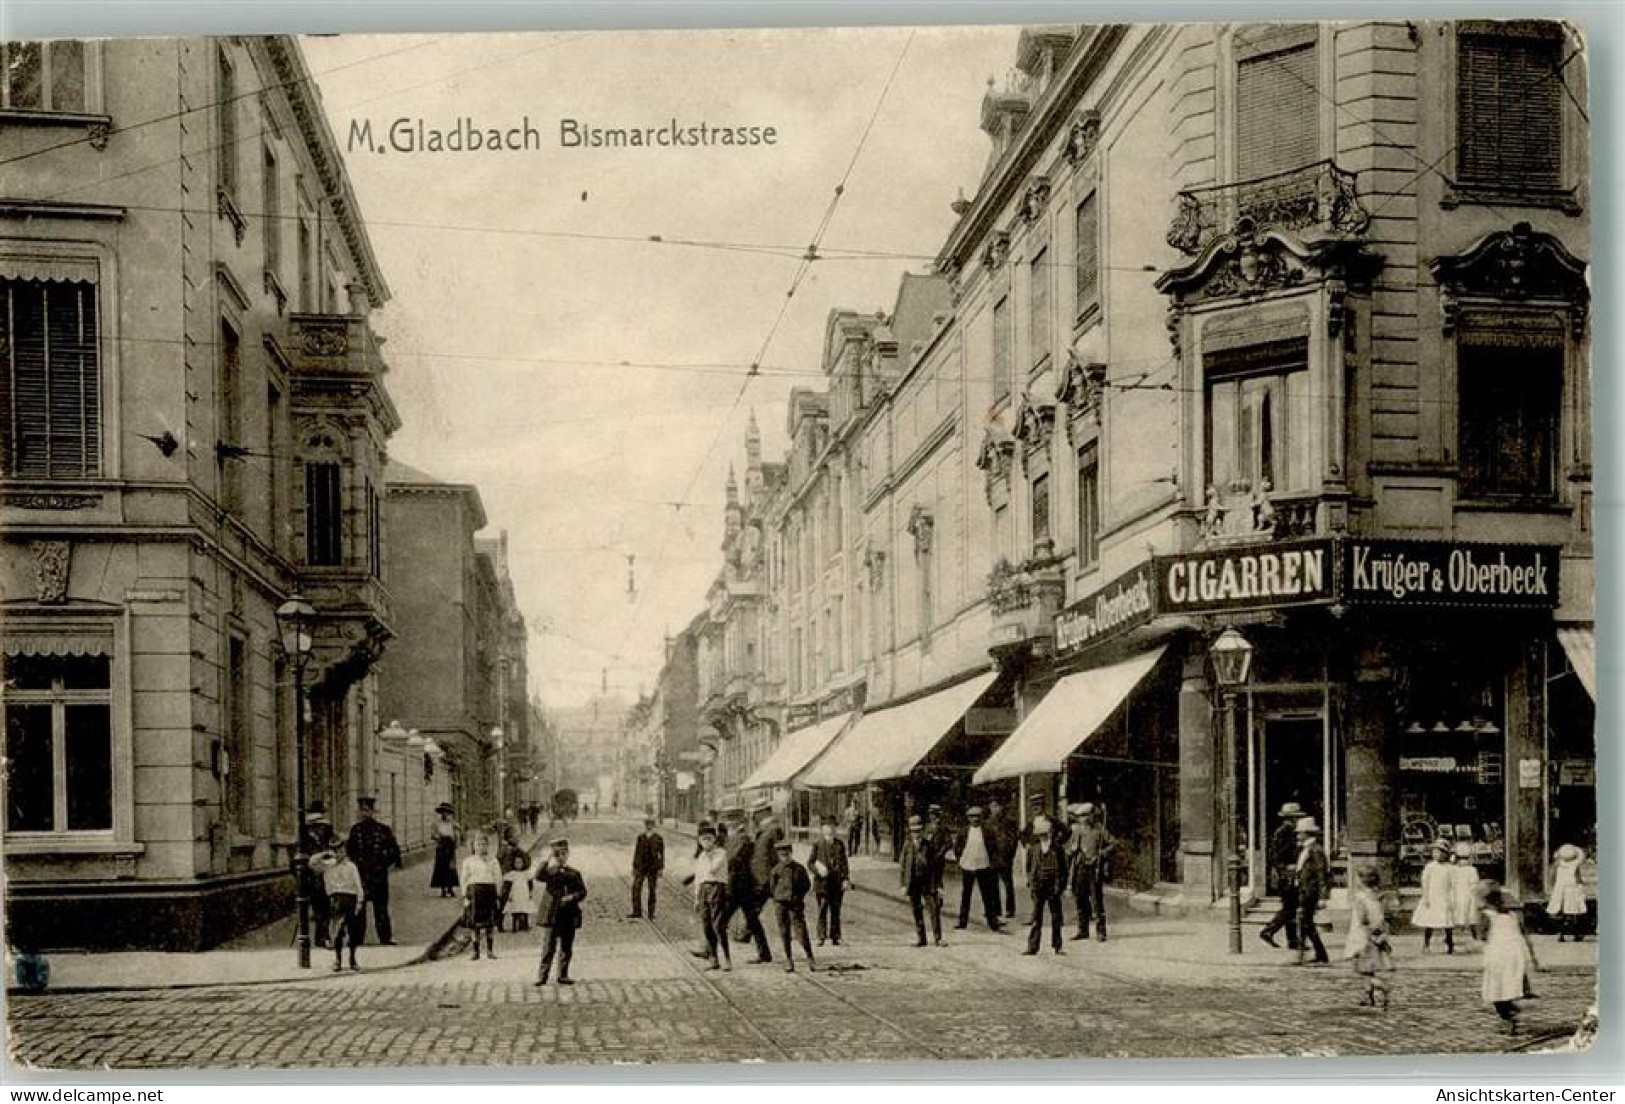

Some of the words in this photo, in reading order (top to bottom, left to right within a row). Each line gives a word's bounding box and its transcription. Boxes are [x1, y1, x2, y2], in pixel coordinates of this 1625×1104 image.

[1168, 549, 1324, 603] CIGARREN
[1353, 546, 1430, 598] Krüger
[1432, 568, 1444, 593] &
[1450, 550, 1548, 595] Oberbeck
